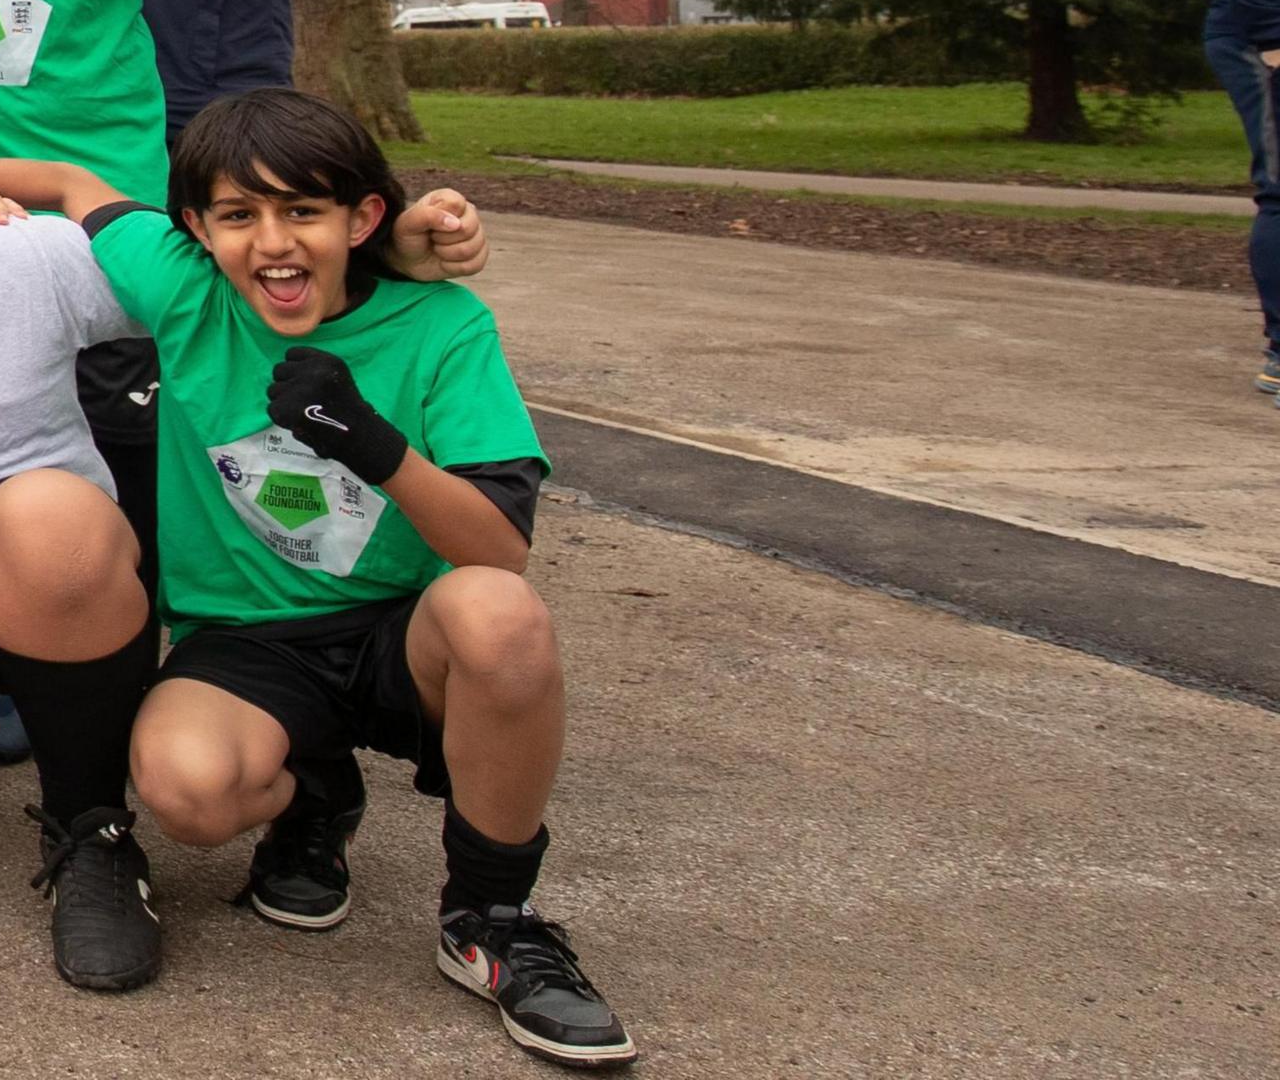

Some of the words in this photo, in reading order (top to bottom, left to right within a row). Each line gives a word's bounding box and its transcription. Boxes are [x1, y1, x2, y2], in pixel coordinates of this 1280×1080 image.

[267, 445, 280, 454] UK
[270, 484, 314, 500] FOOTBALL
[263, 494, 321, 512] FOUNDATION
[268, 530, 312, 550] TOGETHER
[279, 544, 319, 562] FOOTBALL
